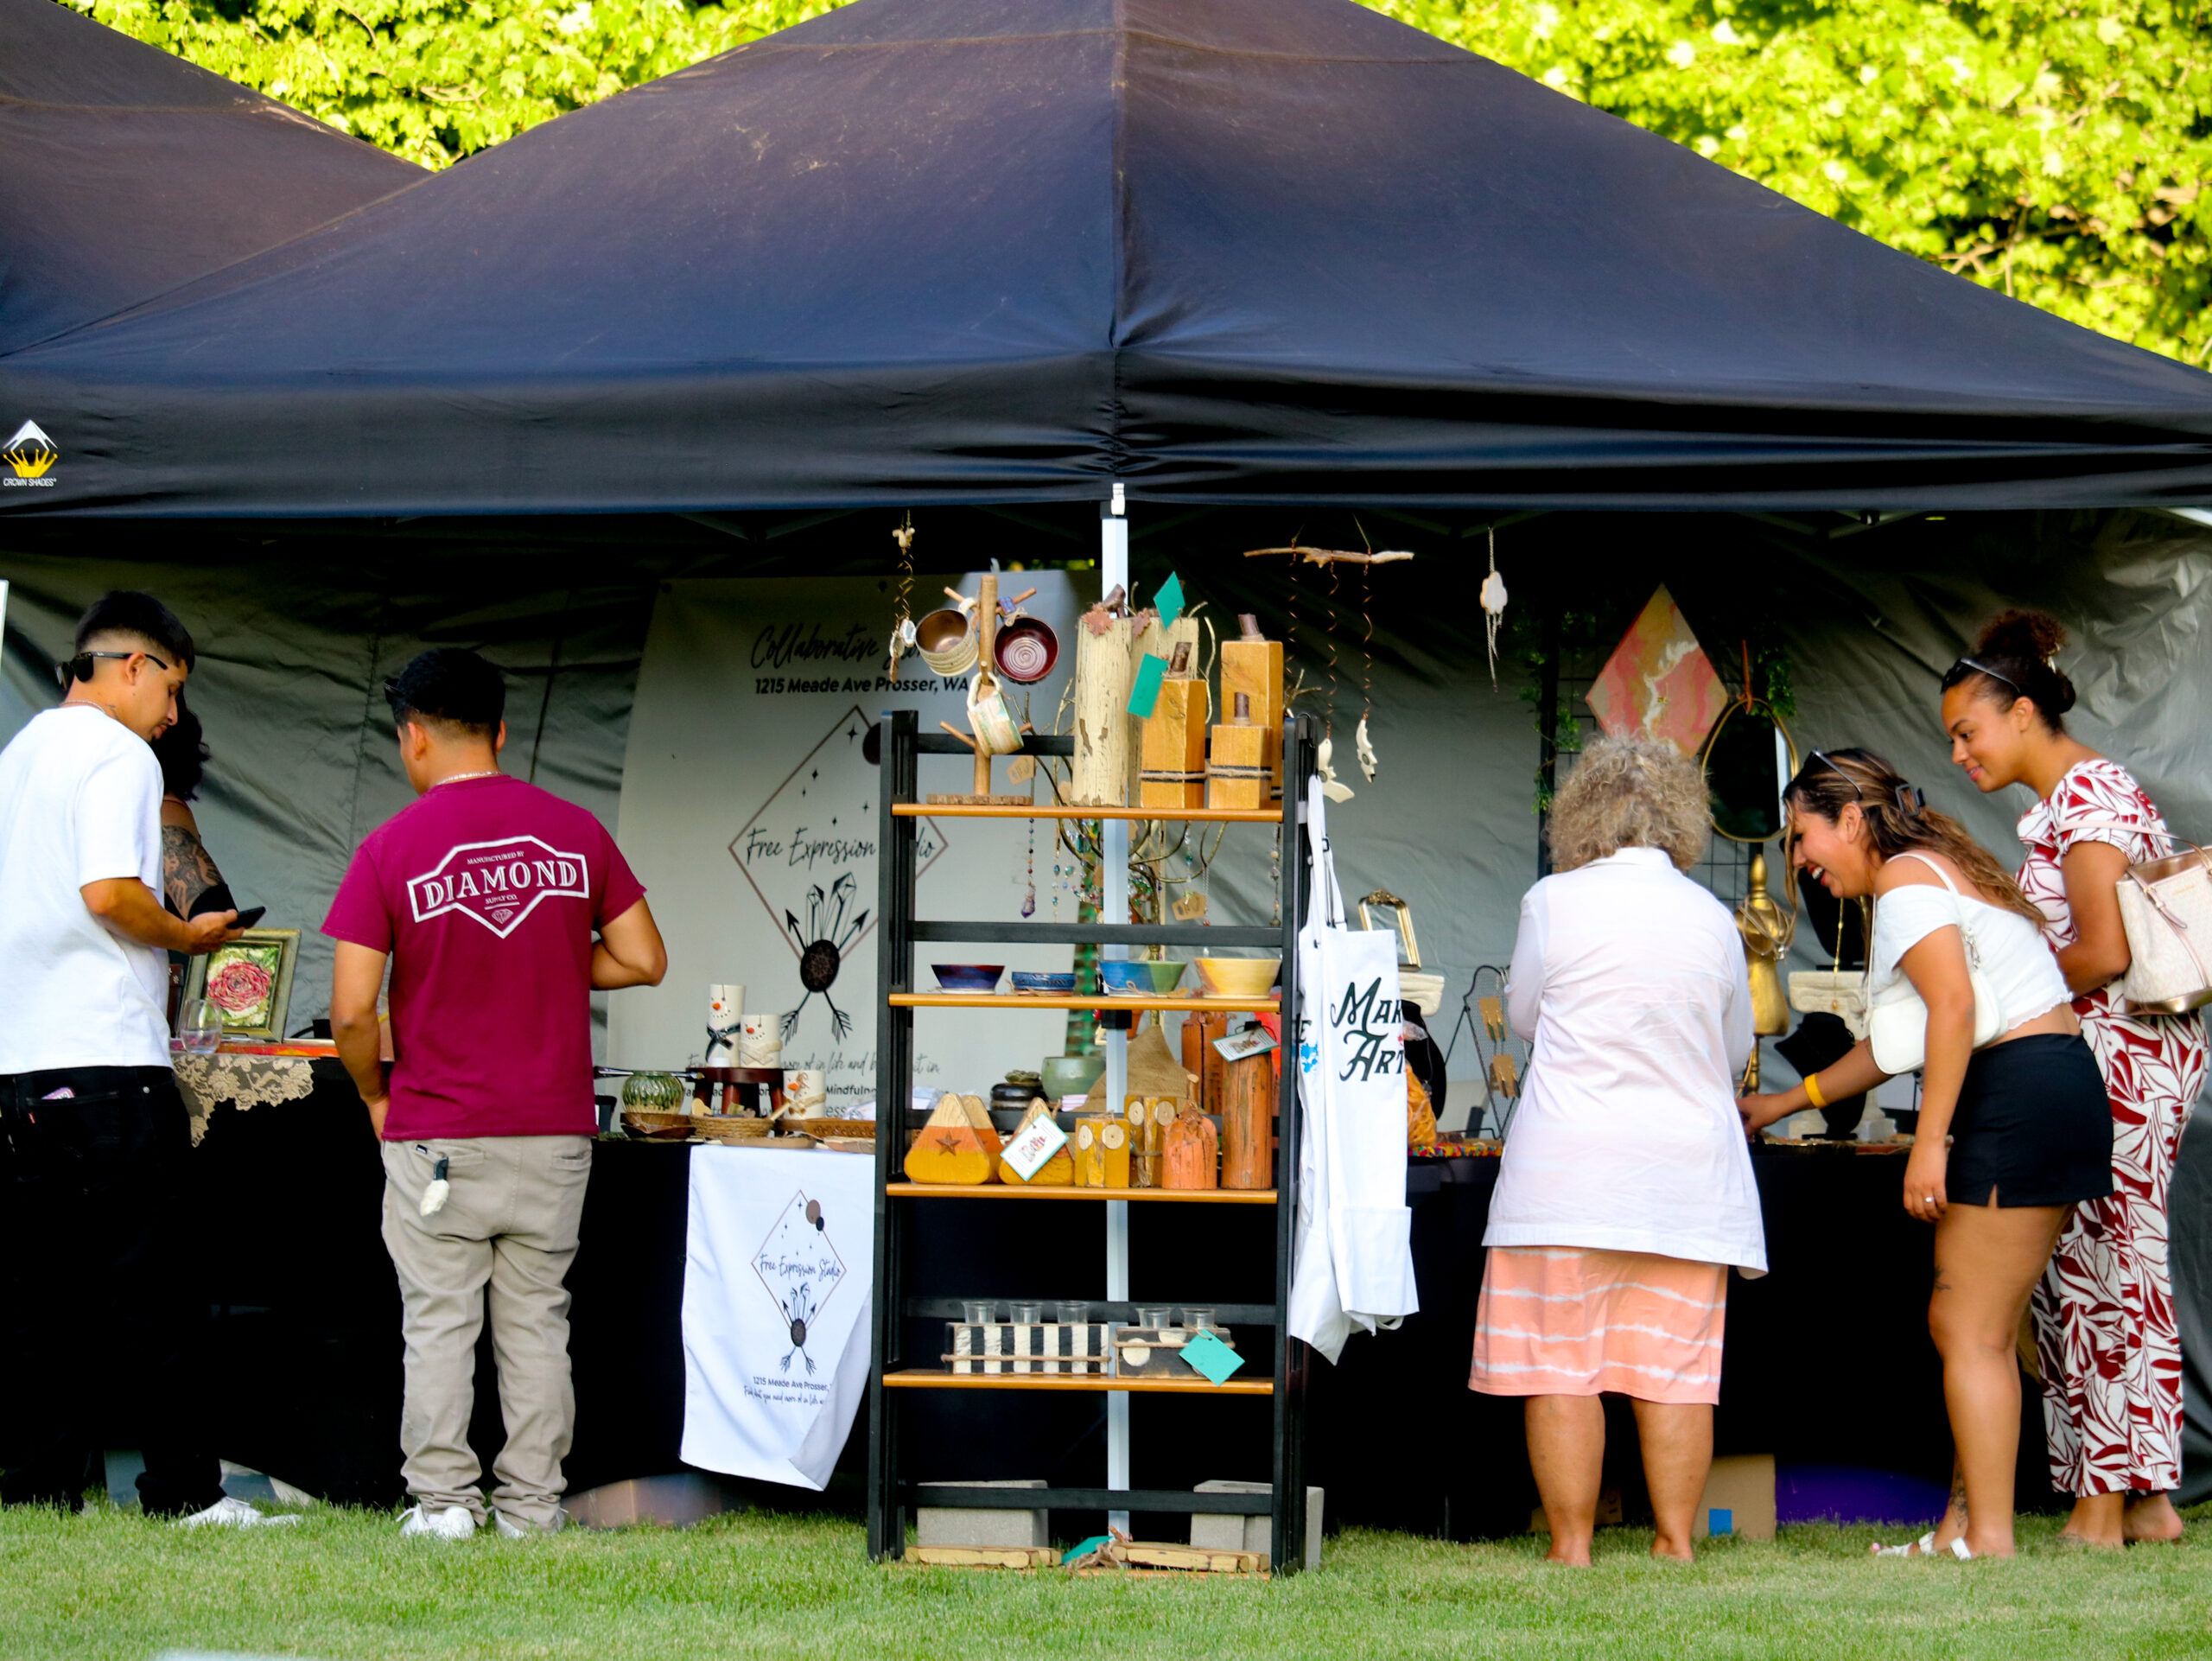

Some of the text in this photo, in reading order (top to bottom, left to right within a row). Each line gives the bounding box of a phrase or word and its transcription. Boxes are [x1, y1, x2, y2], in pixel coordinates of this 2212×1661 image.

[3, 478, 27, 487] CROWN
[751, 623, 880, 669] Collaborative
[755, 678, 785, 694] 1215
[788, 678, 839, 693] Meade
[842, 678, 872, 692] Ave
[467, 852, 517, 865] MANUFACTURED
[747, 827, 783, 865] Free
[789, 827, 876, 871] Expression
[423, 861, 578, 910] DIAMOND
[760, 1253, 841, 1282] Free Expression Studio
[753, 1376, 766, 1385] 1215
[768, 1378, 790, 1388] Meade
[791, 1381, 803, 1390] Ave
